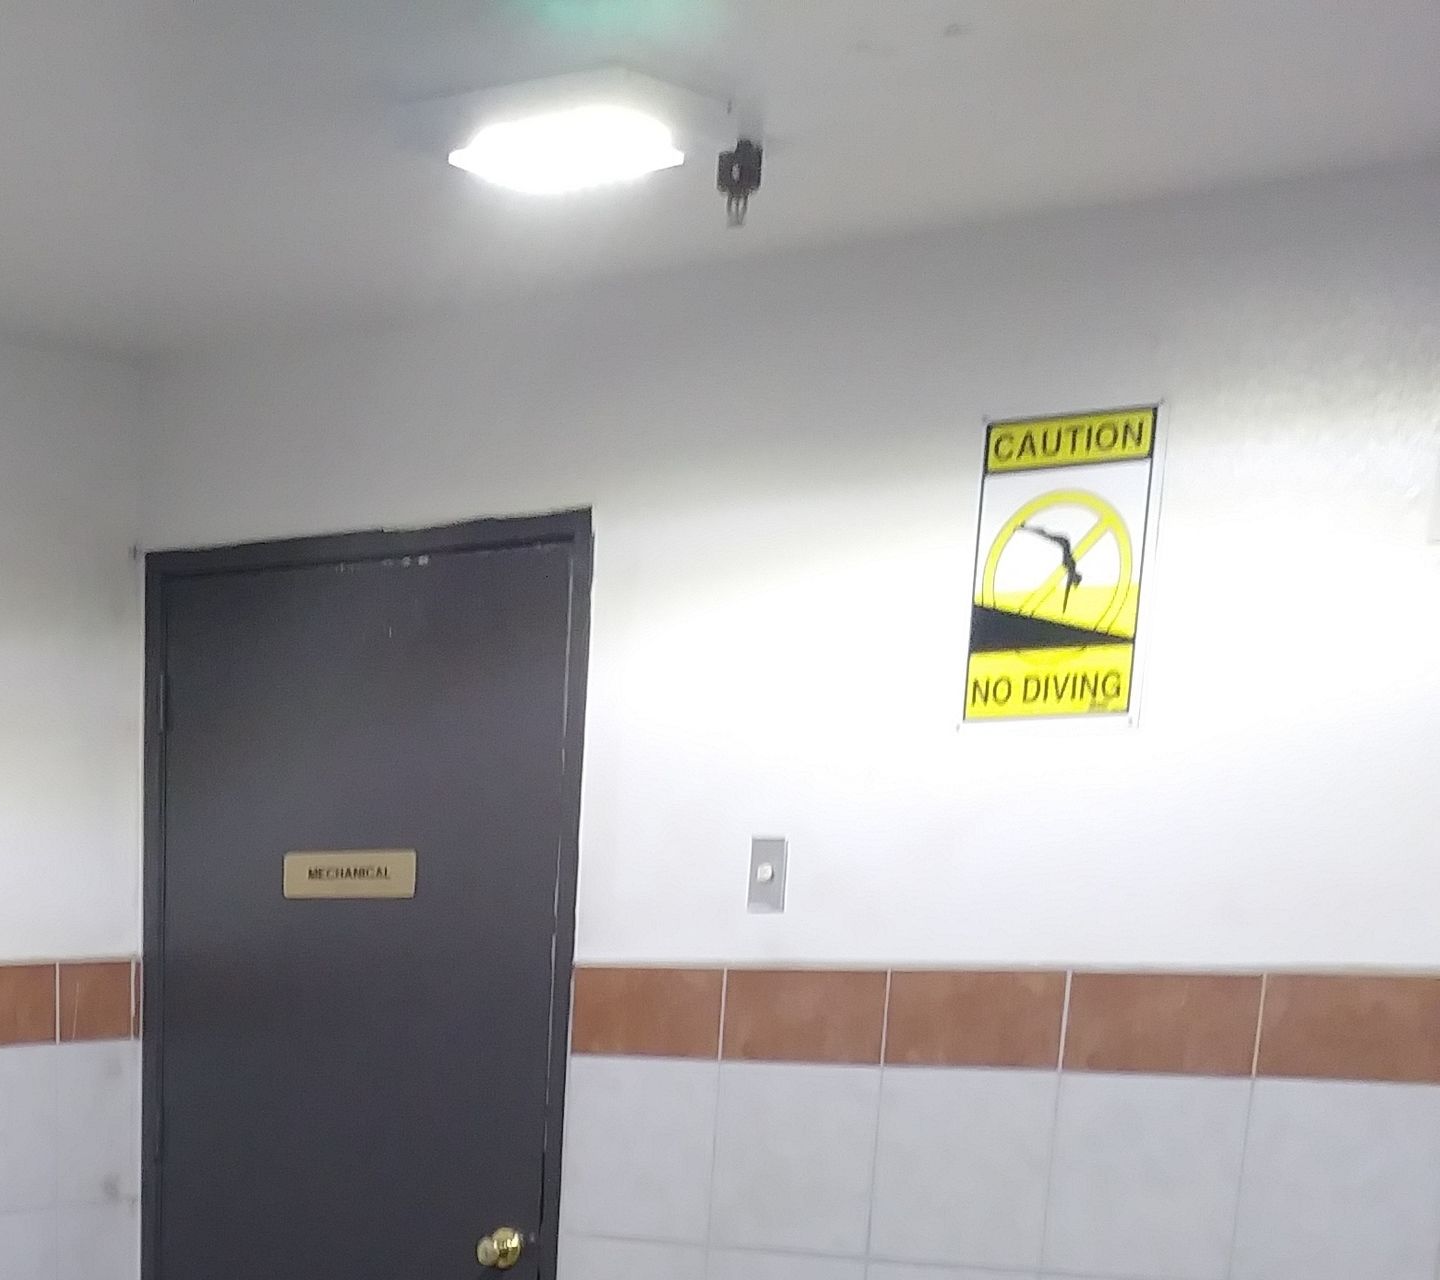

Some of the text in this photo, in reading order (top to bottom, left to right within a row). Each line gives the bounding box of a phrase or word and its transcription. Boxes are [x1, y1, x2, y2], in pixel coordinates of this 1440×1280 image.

[993, 417, 1145, 462] CAUTION
[970, 676, 1012, 706] NO
[1022, 668, 1122, 705] DIVING
[307, 865, 391, 881] MECHANICAL
